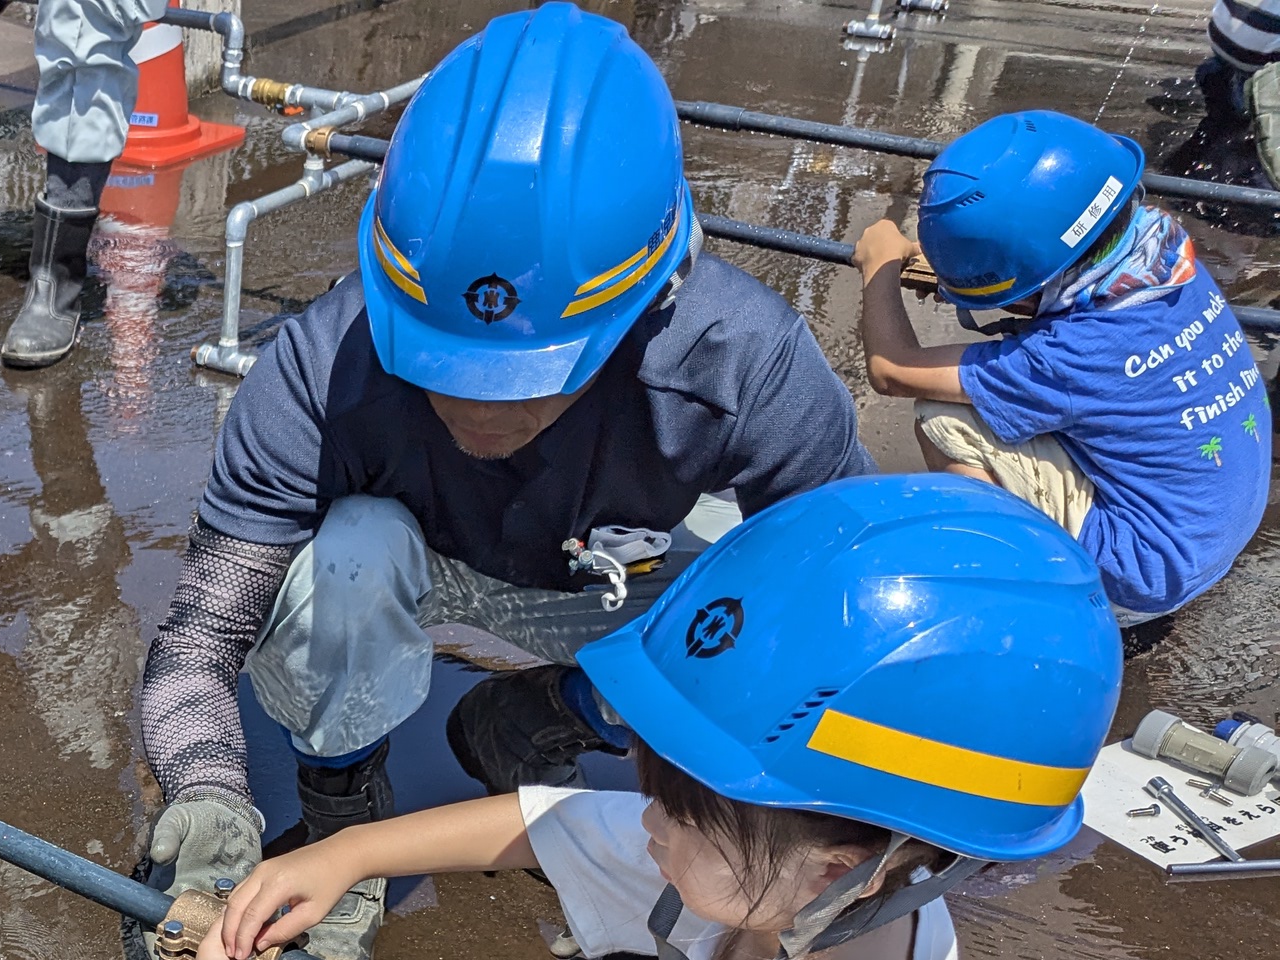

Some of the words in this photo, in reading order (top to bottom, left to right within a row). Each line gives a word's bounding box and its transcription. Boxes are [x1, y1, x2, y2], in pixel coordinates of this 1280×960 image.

[1071, 185, 1117, 237] 研修用
[1124, 343, 1175, 378] Can
[1174, 320, 1205, 351] you
[1172, 369, 1199, 393] it
[1201, 353, 1224, 376] to
[1222, 330, 1244, 358] the
[1179, 382, 1246, 431] finish
